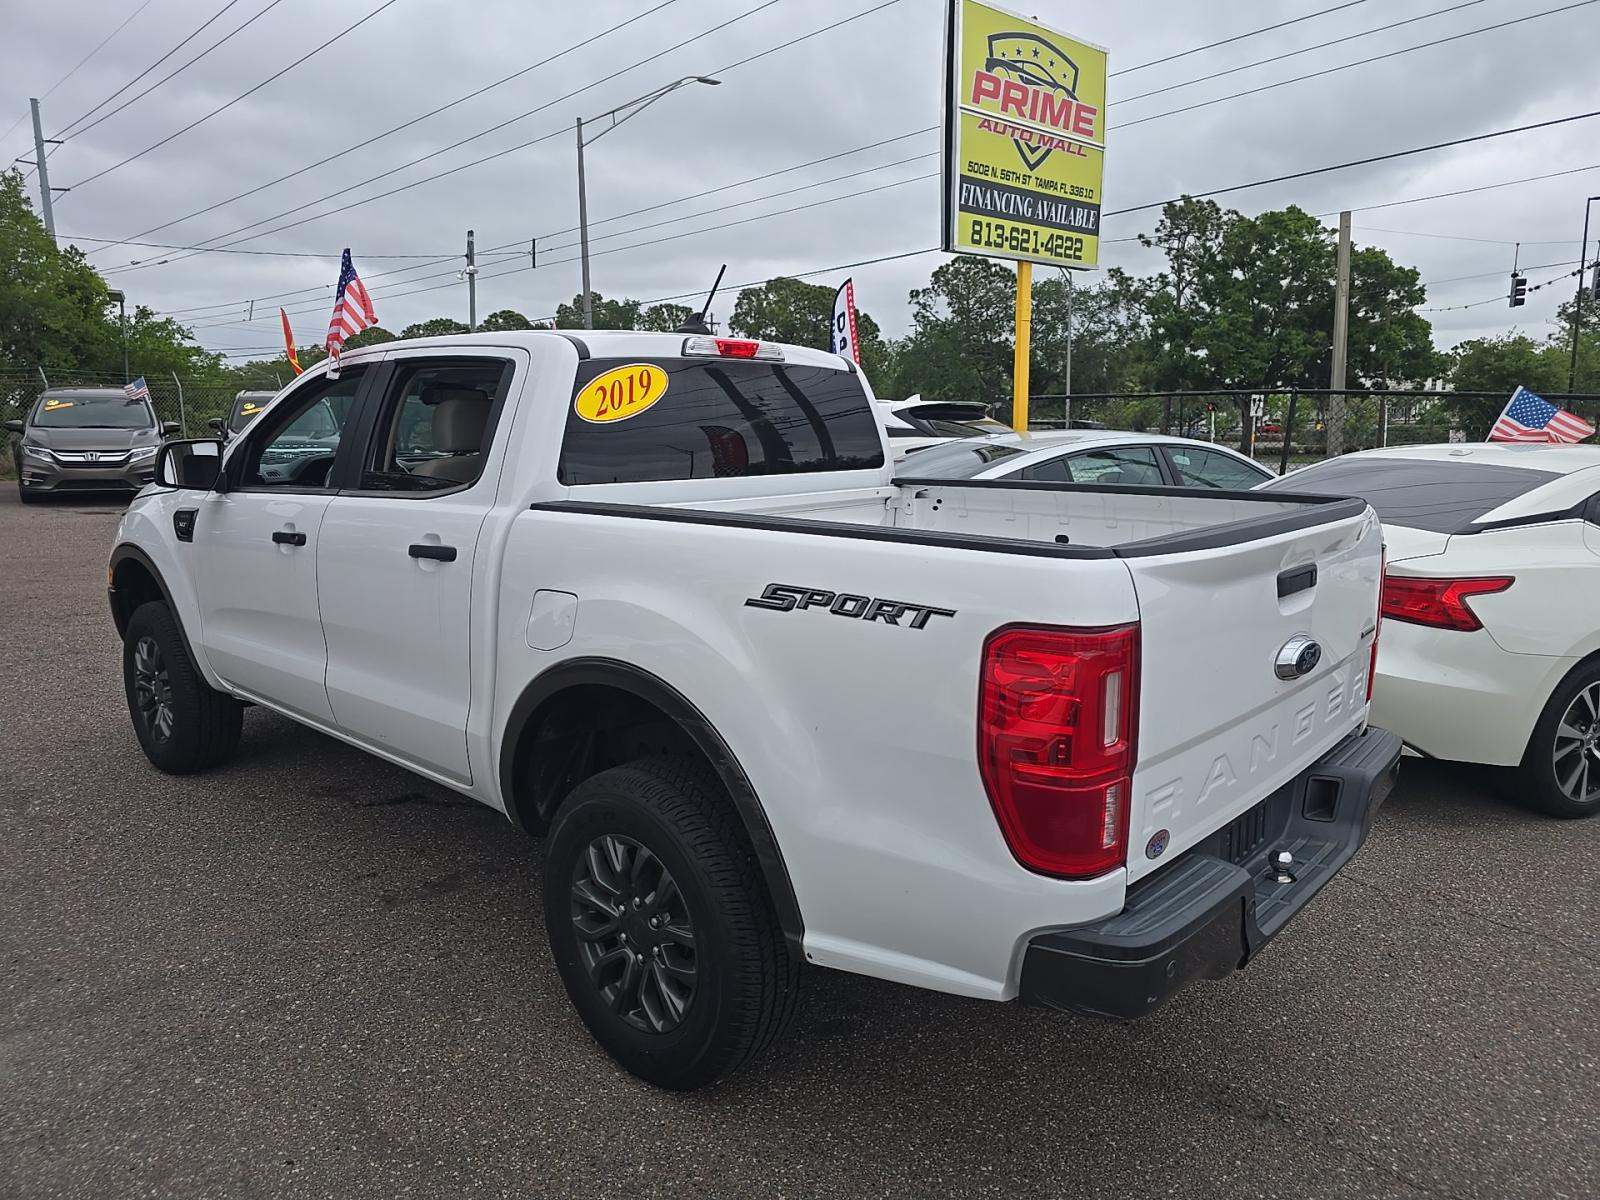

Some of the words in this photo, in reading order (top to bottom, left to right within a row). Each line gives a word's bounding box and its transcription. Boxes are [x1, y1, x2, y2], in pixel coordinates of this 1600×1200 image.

[972, 70, 1097, 137] PRIME
[978, 118, 1033, 142] AUTO
[1037, 134, 1087, 157] MALL
[967, 160, 990, 176] 5002
[991, 166, 999, 179] N.
[1000, 168, 1021, 183] 56TH
[1022, 174, 1032, 186] ST
[1035, 176, 1058, 192] TAMPA
[1060, 182, 1069, 195] FL
[1069, 185, 1094, 199] 33610
[960, 182, 1033, 218] FINANCING
[1034, 199, 1098, 230] AVAILABLE
[594, 369, 652, 418] 2019
[744, 583, 959, 630] SPORT
[1143, 672, 1367, 834] RANGER
